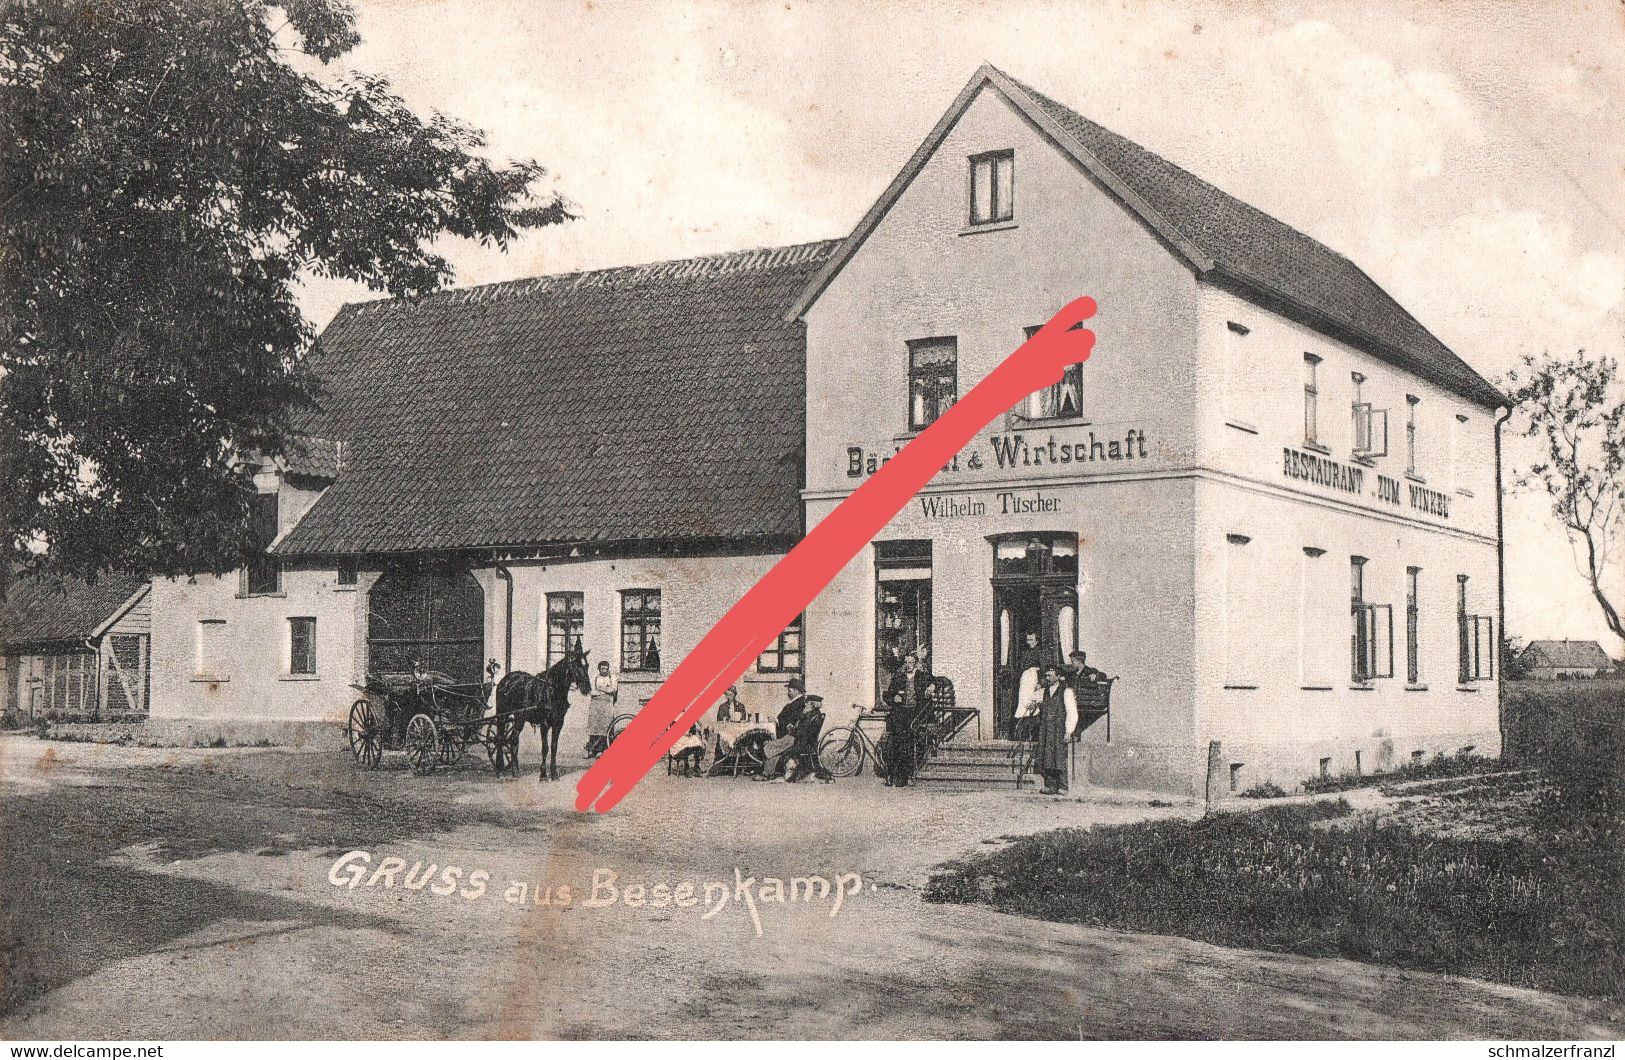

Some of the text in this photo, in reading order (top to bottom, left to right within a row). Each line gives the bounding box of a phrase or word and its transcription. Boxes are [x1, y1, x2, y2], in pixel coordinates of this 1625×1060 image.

[967, 451, 984, 471] &
[990, 429, 1149, 468] Wirtschaft
[1283, 447, 1363, 495] RESTAURANT
[920, 496, 986, 518] Wilhelm
